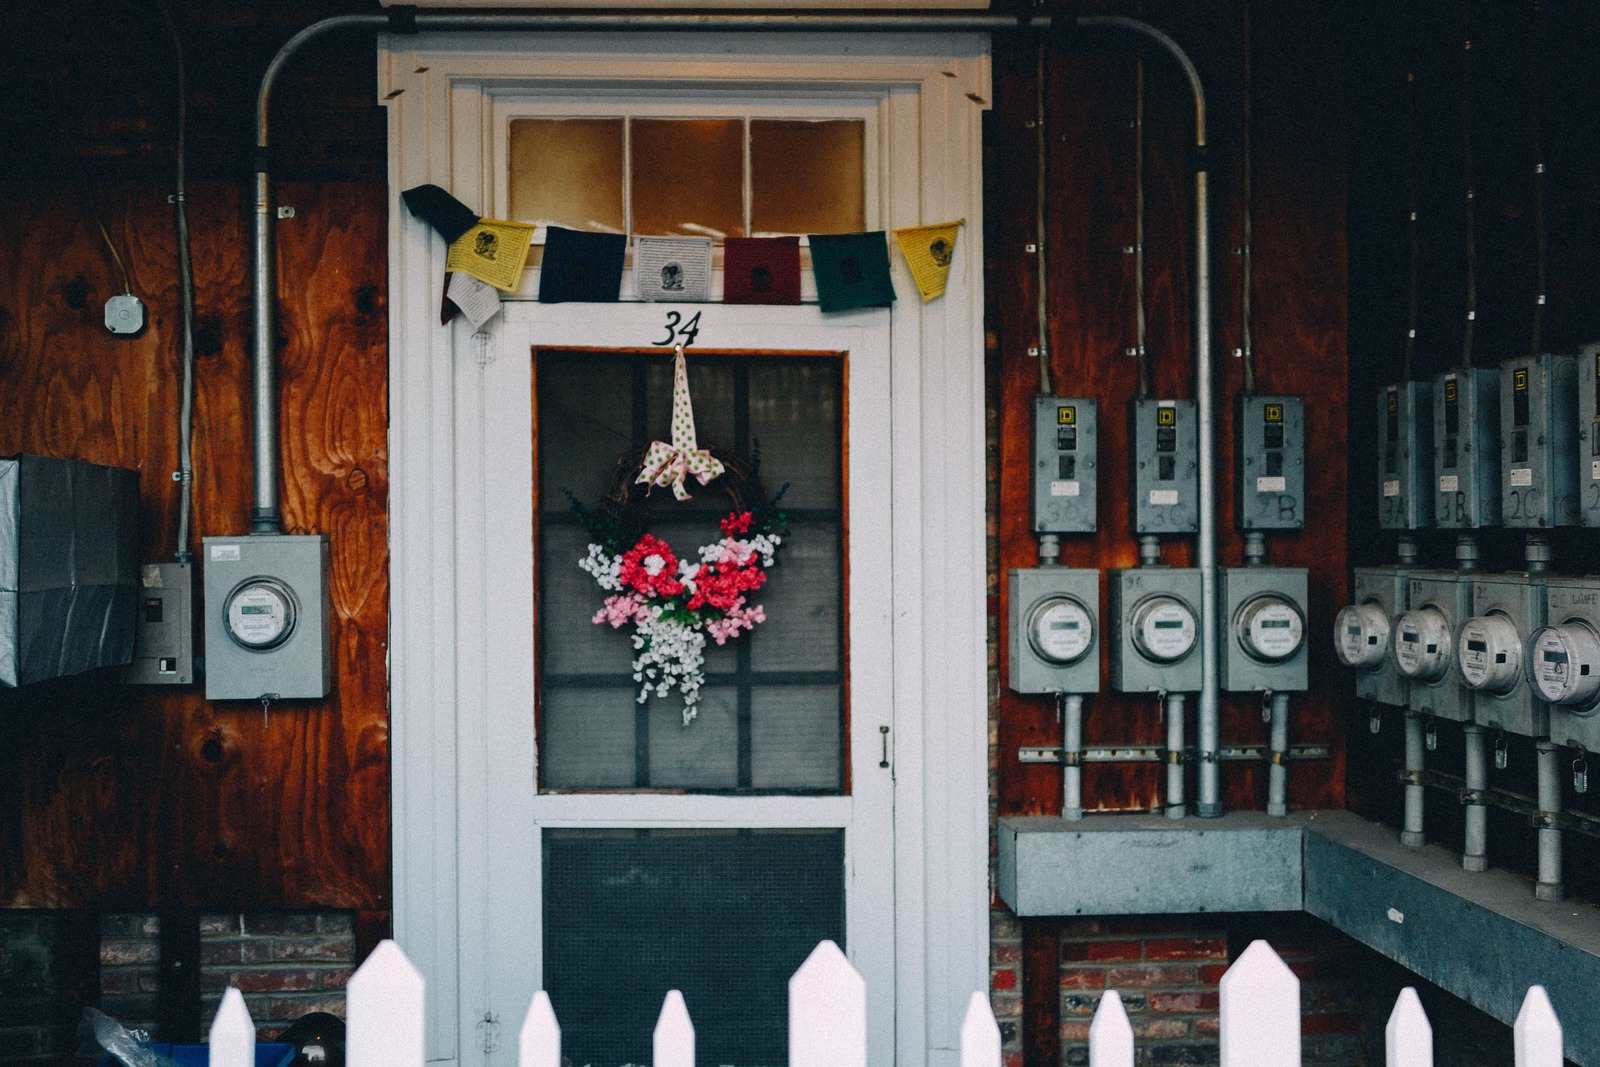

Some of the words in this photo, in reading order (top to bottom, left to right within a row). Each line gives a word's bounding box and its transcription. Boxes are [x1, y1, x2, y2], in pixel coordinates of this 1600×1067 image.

[652, 310, 701, 348] 34
[1440, 491, 1466, 522] 3B
[1510, 488, 1537, 520] 2C
